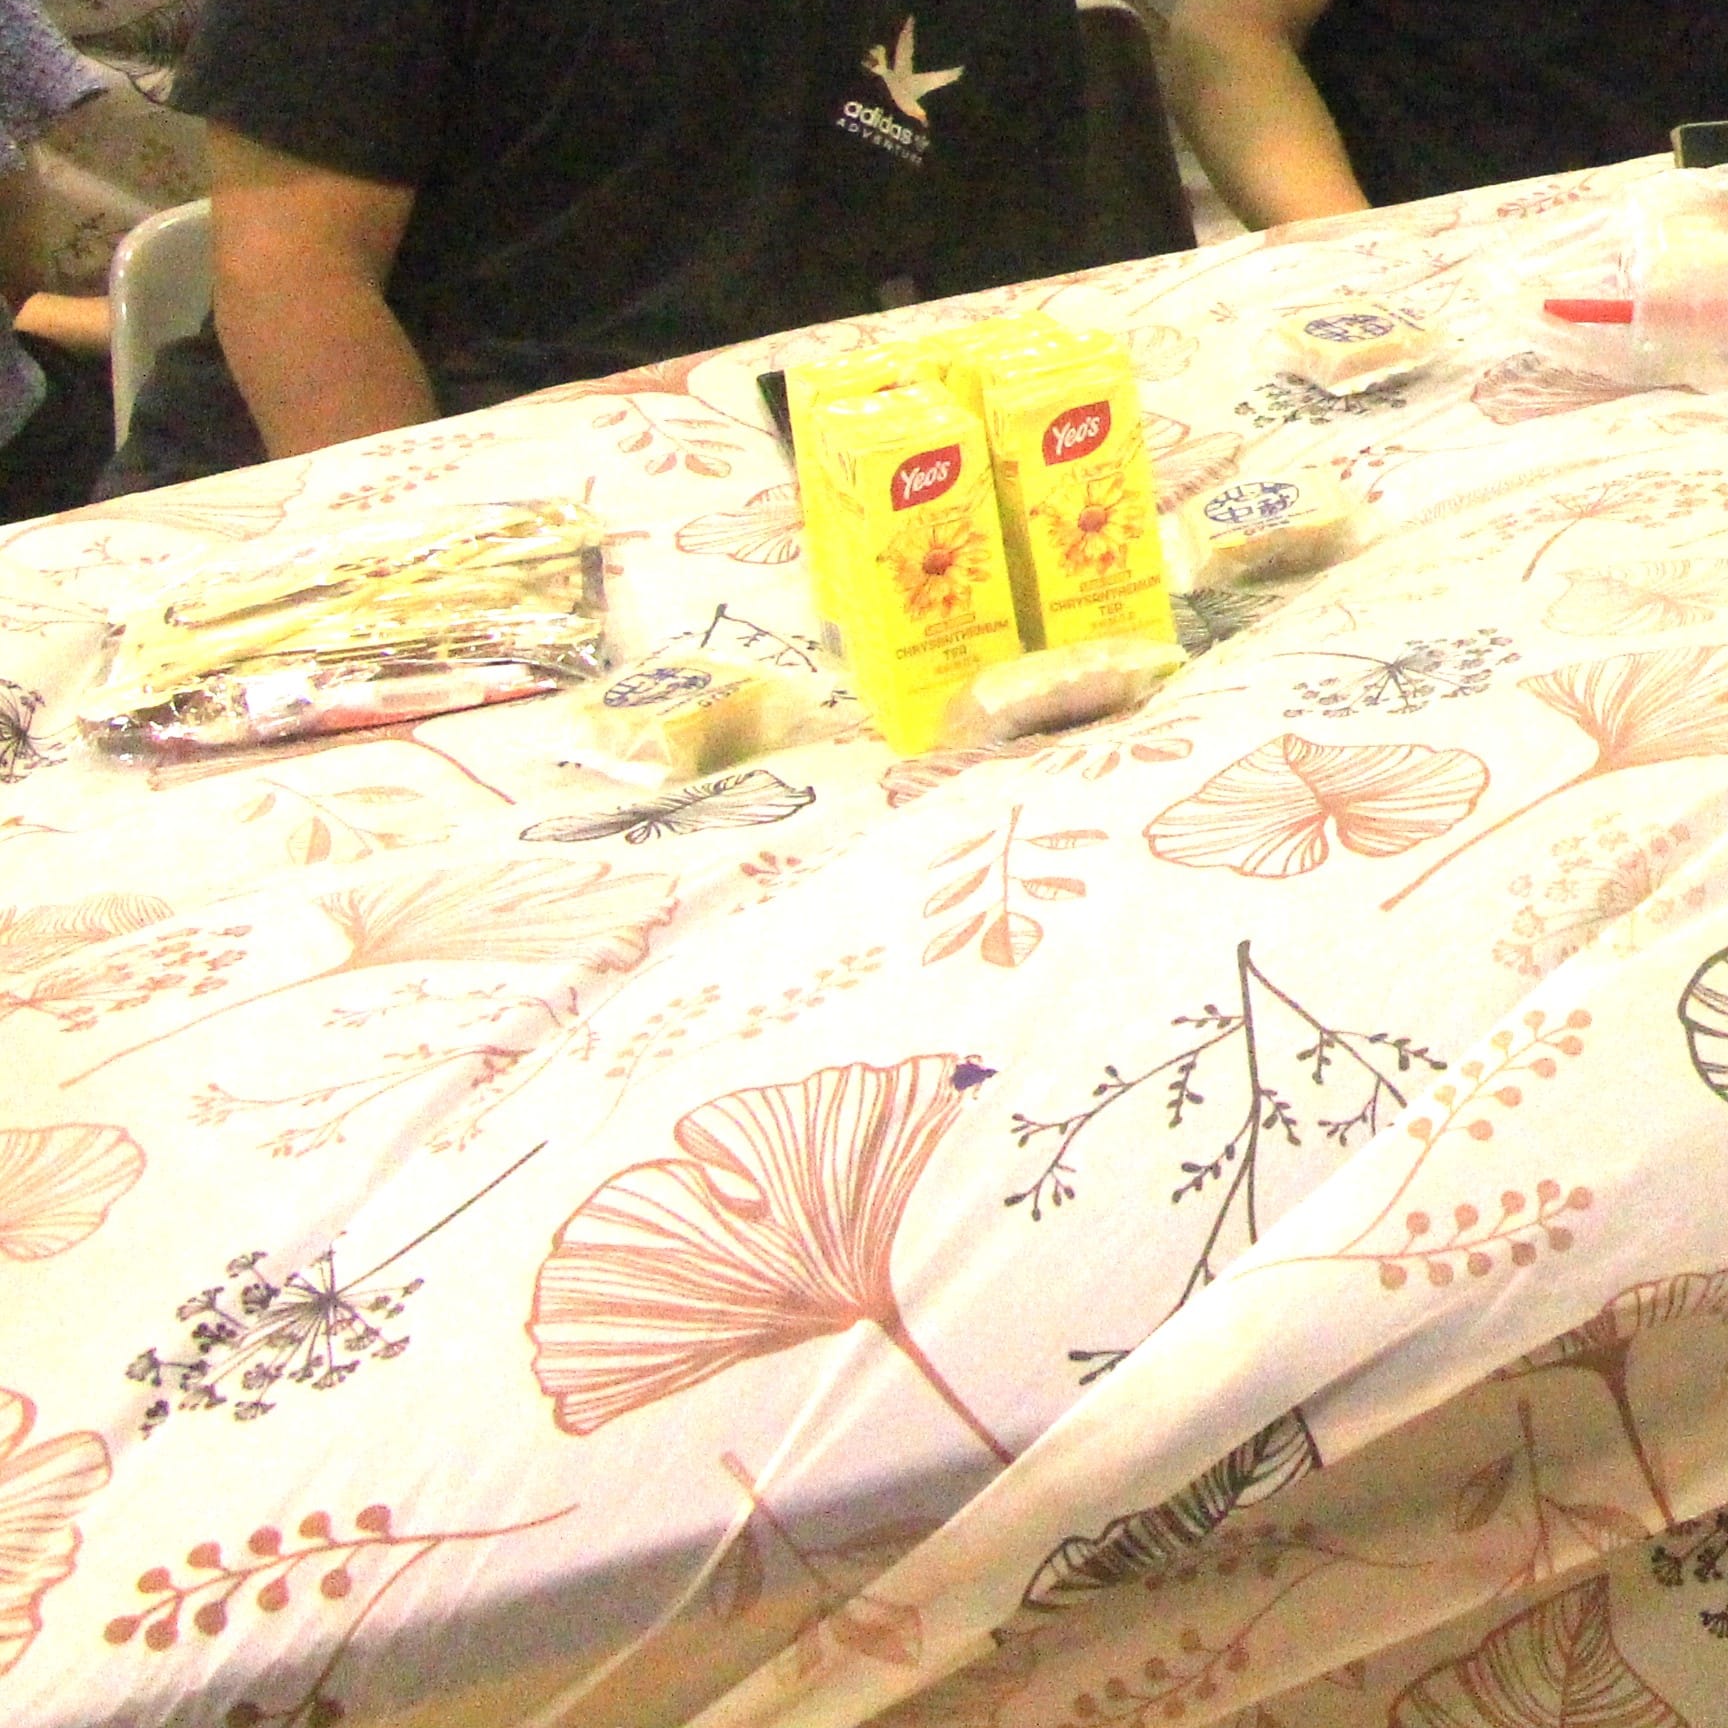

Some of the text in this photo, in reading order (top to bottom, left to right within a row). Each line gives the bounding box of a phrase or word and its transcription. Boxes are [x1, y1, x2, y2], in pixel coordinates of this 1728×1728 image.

[843, 100, 913, 145] adidas
[1052, 415, 1102, 457] Yeo's
[900, 460, 951, 501] Yeo's
